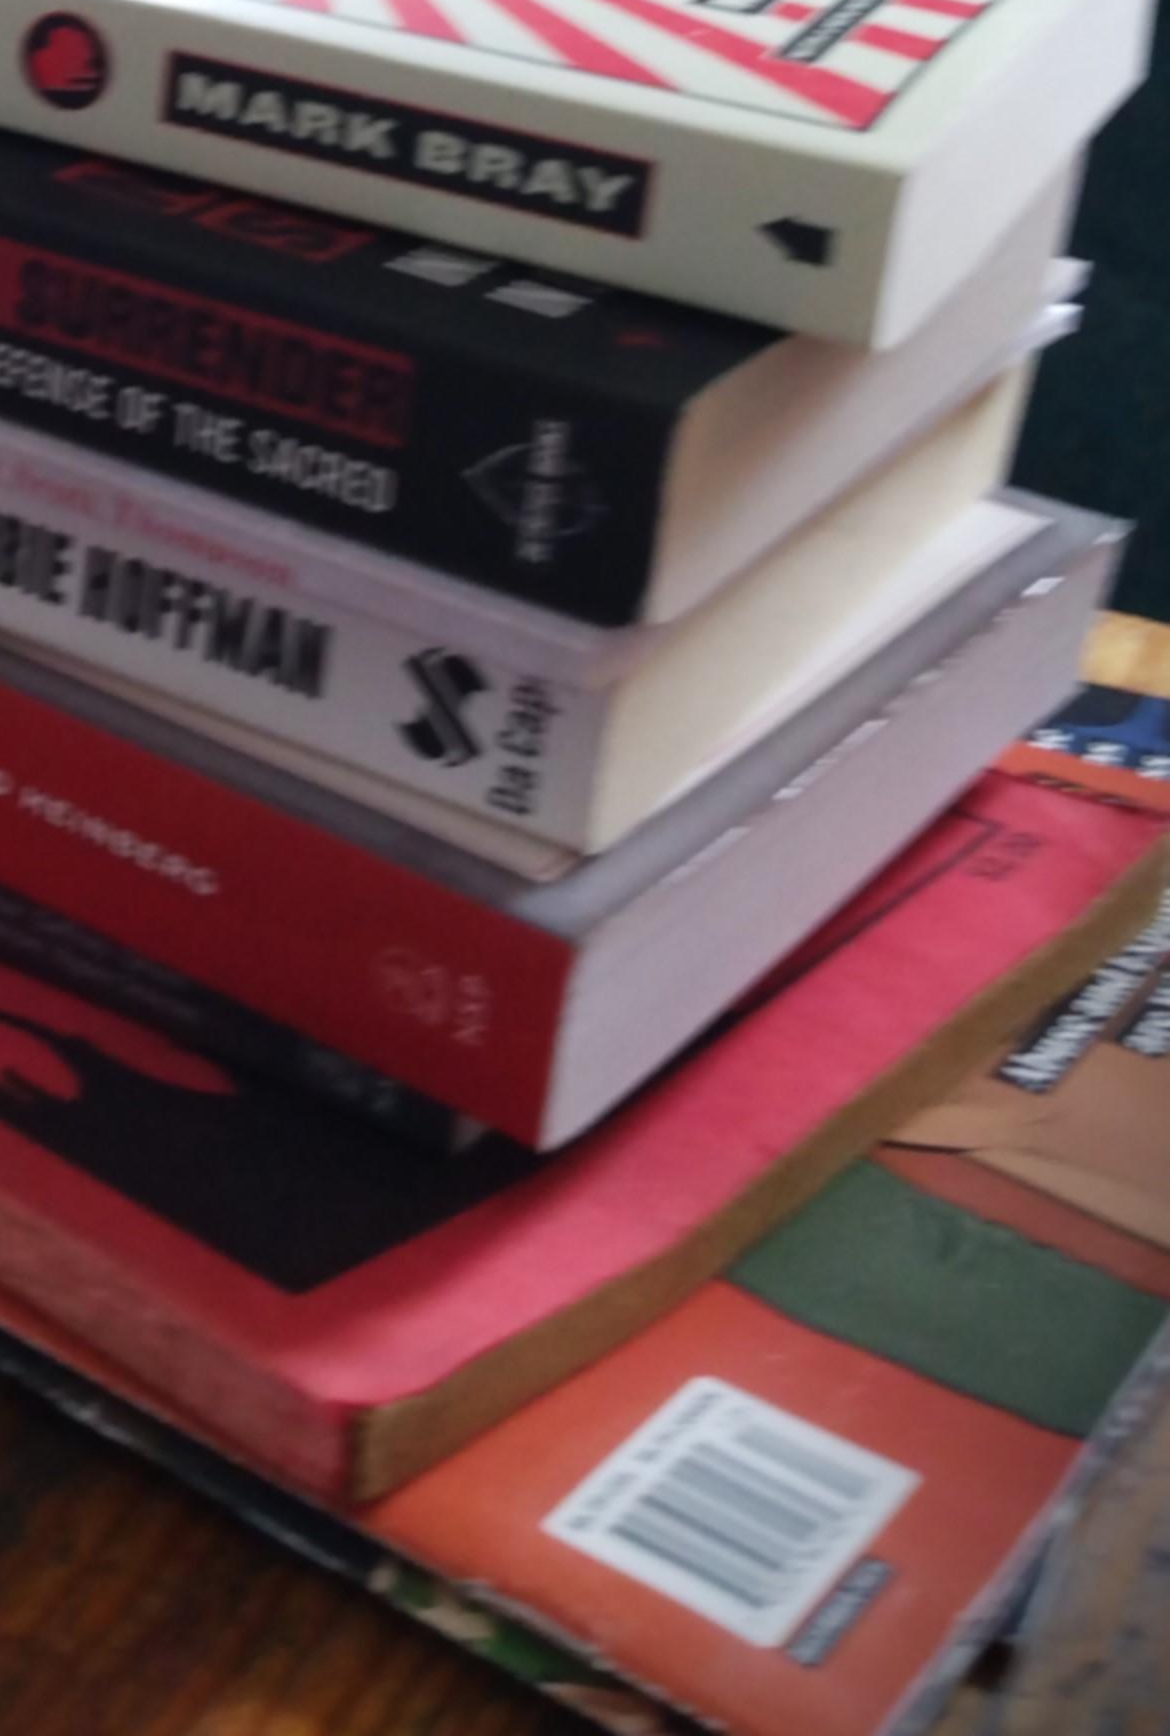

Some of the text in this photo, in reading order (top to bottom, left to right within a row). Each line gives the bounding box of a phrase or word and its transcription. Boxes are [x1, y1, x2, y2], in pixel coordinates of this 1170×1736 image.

[176, 69, 400, 160] MARK
[414, 130, 638, 213] BRAY
[21, 258, 413, 441] SURRENDER
[115, 386, 168, 433] OF
[171, 401, 244, 463] THE
[247, 428, 397, 513] SACRED
[77, 544, 335, 700] HOFFMAN
[17, 784, 221, 896] HEINBERG
